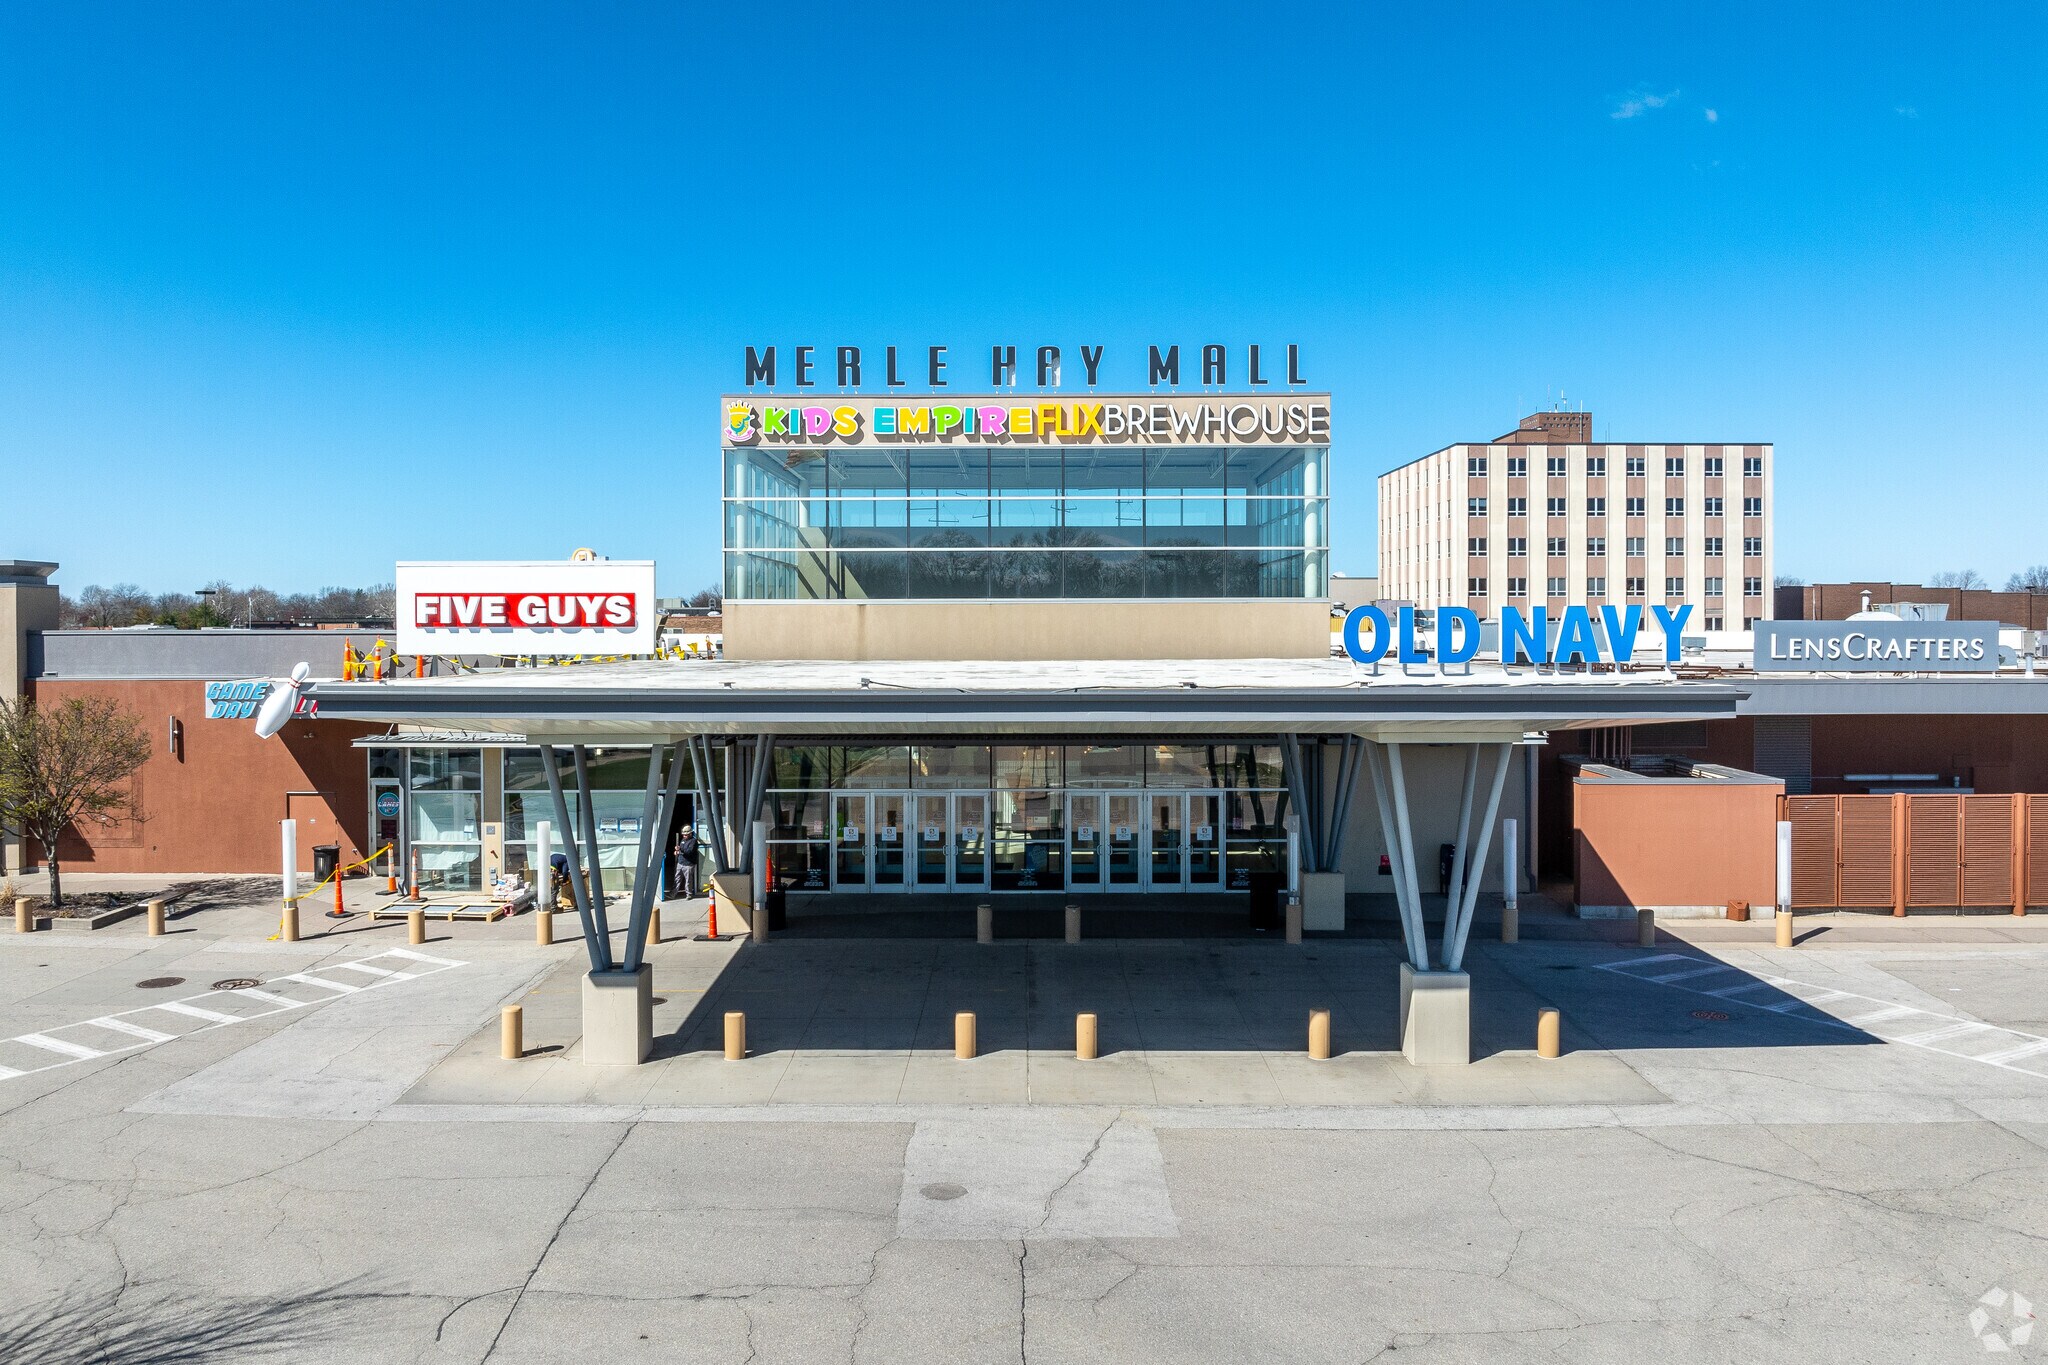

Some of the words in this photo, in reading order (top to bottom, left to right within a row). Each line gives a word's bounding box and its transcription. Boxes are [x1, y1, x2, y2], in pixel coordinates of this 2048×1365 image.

[745, 345, 948, 387] MERLE
[992, 345, 1105, 387] HAY
[1148, 344, 1308, 386] MALL
[763, 405, 859, 437] KIDS
[873, 405, 1034, 437] EMPIRE
[1037, 403, 1106, 436] FLIX
[1105, 404, 1327, 436] BREWHOUSE
[416, 595, 506, 625] FIVE
[517, 595, 632, 625] GUYS
[1343, 604, 1482, 665] OLD
[1501, 604, 1694, 665] NAVY
[1769, 632, 1985, 661] LENSCRAFTERS
[206, 682, 268, 700] GAME
[211, 701, 257, 719] DAY
